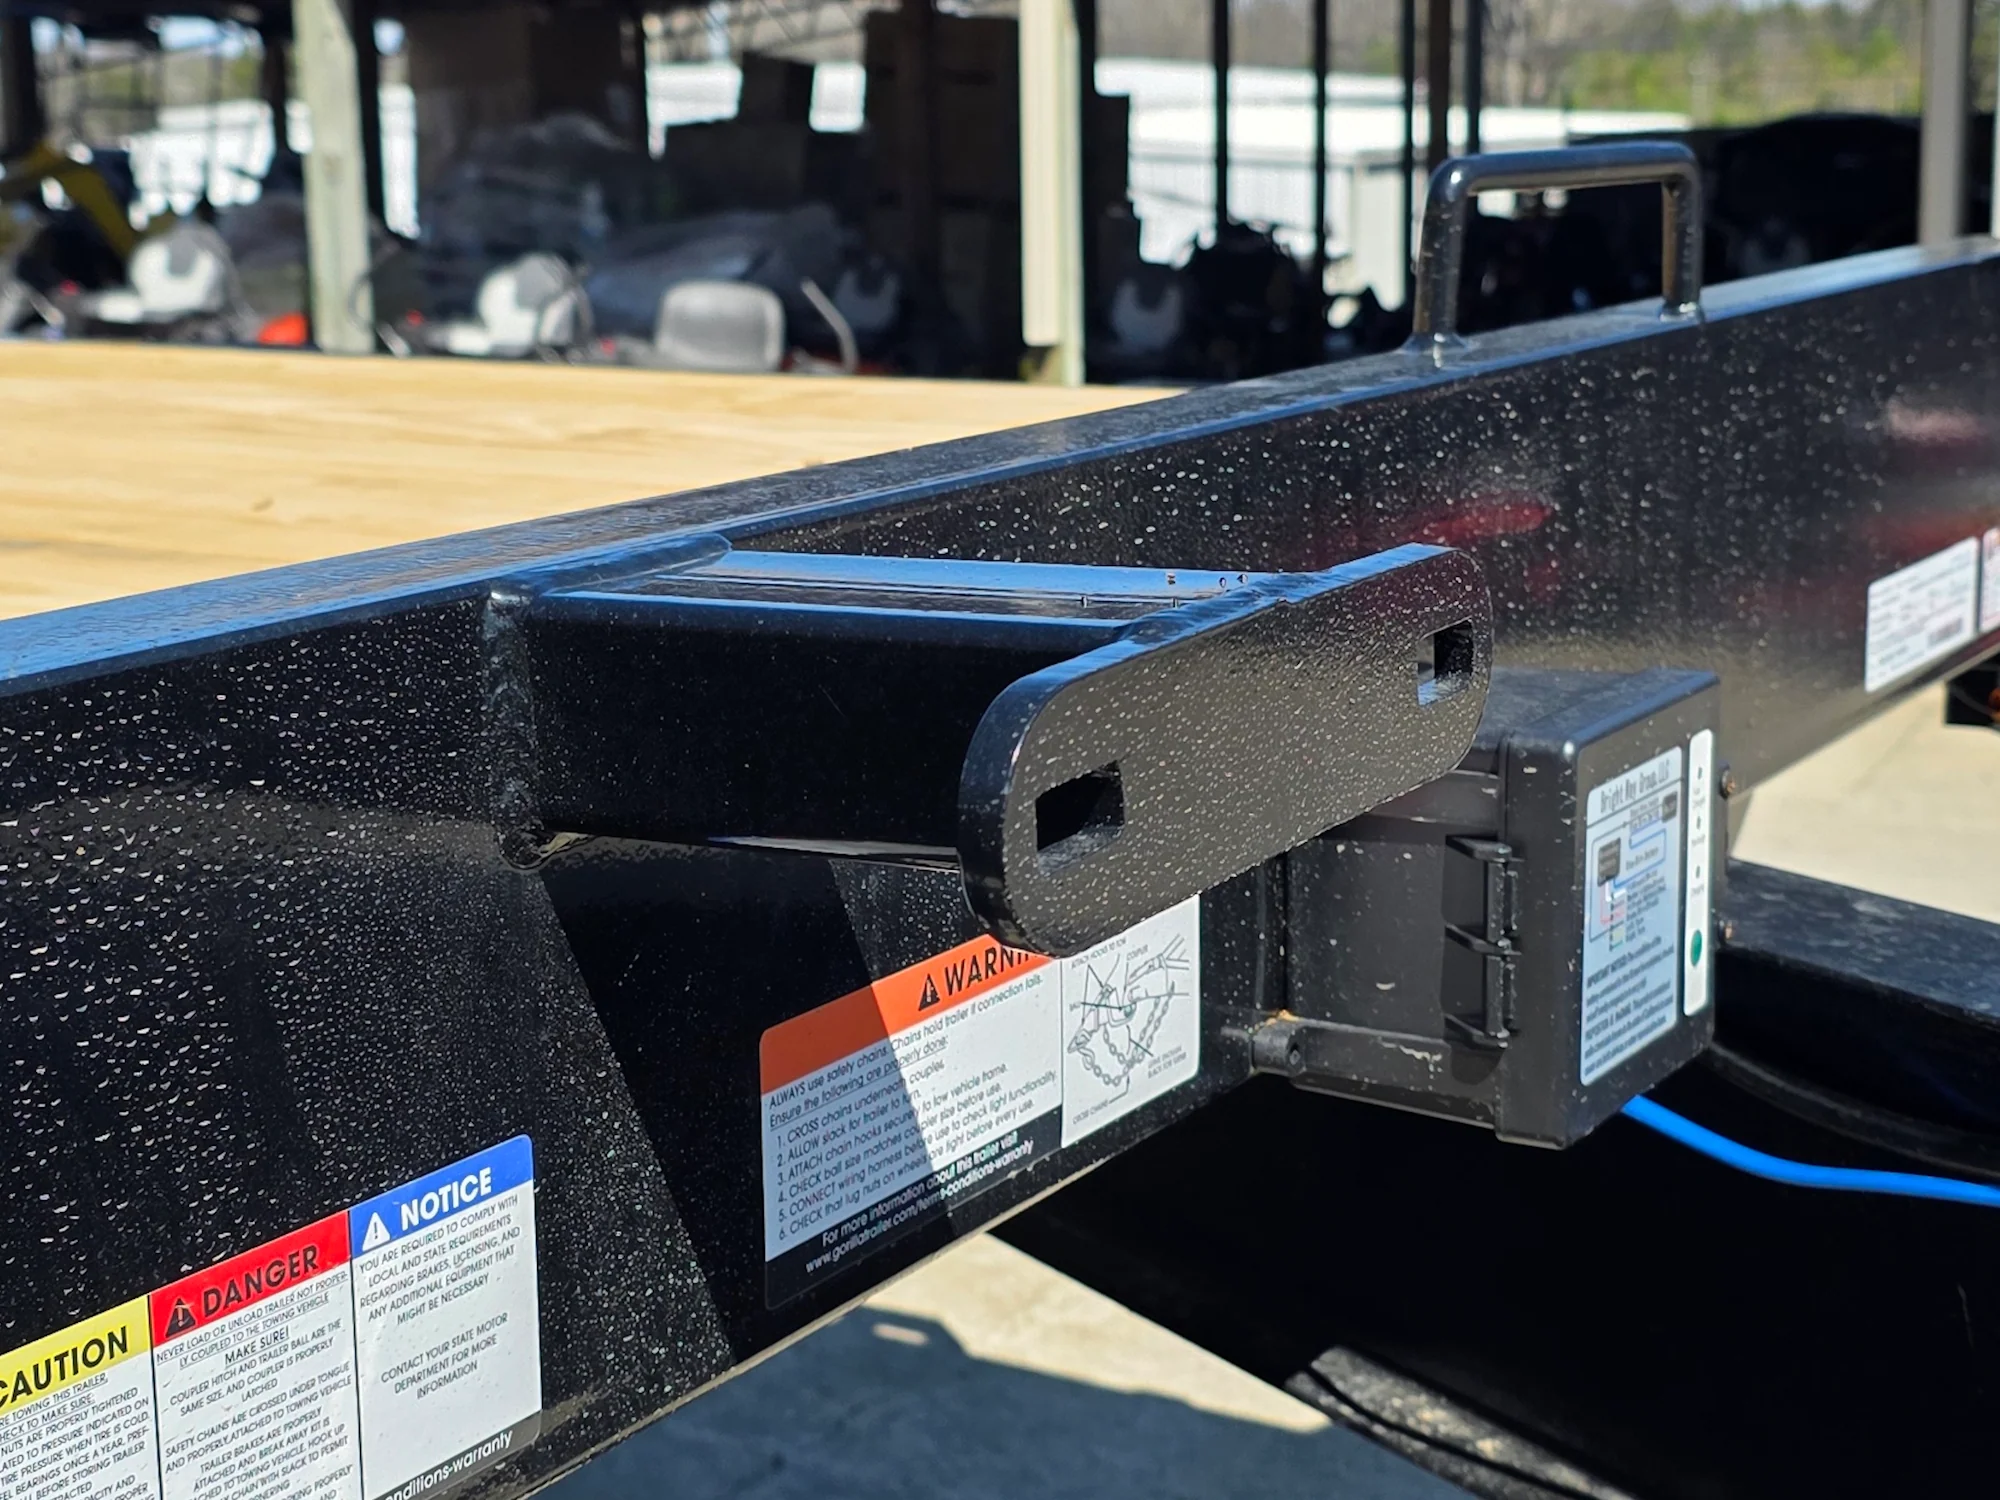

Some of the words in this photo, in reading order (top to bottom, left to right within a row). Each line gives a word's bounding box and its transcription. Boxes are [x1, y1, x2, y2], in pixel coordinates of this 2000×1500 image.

[945, 946, 1037, 996] WARN
[769, 1081, 805, 1109] ALWAYS
[807, 1076, 823, 1092] use
[826, 1058, 854, 1084] safety
[891, 1027, 921, 1053] Chains
[923, 1017, 942, 1038] hold
[977, 979, 1023, 1012] connection
[770, 1101, 801, 1128] Ensure
[804, 1092, 819, 1111] the
[821, 1072, 863, 1105] following
[866, 1066, 881, 1082] are
[884, 1046, 920, 1075] properly
[777, 1132, 785, 1148] 1.
[787, 1116, 818, 1143] CROSS
[821, 1100, 851, 1127] chains
[854, 1074, 905, 1111] underneath
[777, 1151, 785, 1168] 2.
[788, 1135, 819, 1162] ALLOW
[822, 1122, 845, 1145] slack
[848, 1115, 861, 1132] for
[863, 1101, 888, 1125] trailer
[890, 1095, 900, 1110] to
[777, 1170, 786, 1186] 3.
[788, 1152, 822, 1181] ATTACH
[825, 1137, 852, 1162] chain
[854, 1122, 881, 1147] hooks
[789, 1171, 821, 1198] CHECK
[824, 1160, 841, 1181] ball
[844, 1151, 860, 1170] size
[863, 1130, 901, 1161] matches
[400, 1166, 493, 1231] NOTICE
[789, 1181, 835, 1217] CONNECT
[837, 1166, 865, 1194] wiring
[867, 1147, 902, 1176] harness
[935, 1124, 949, 1141] use
[789, 1206, 822, 1235] CHECK
[825, 1195, 842, 1216] that
[862, 1178, 880, 1196] nuts
[883, 1171, 894, 1185] on
[822, 1225, 837, 1248] For
[841, 1211, 867, 1238] more
[870, 1179, 924, 1222] information
[926, 1162, 955, 1192] about
[956, 1153, 972, 1175] this
[973, 1139, 999, 1166] trailer
[359, 1256, 379, 1274] YOU
[381, 1247, 398, 1265] ARE
[400, 1227, 444, 1256] REQUIRED
[446, 1221, 458, 1236] TO
[460, 1204, 496, 1229] COMPLY
[498, 1193, 518, 1213] WITH
[359, 1274, 414, 1309] REGARDING
[501, 1225, 520, 1244] AND
[368, 1263, 399, 1287] LOCAL
[401, 1253, 421, 1272] AND
[423, 1241, 447, 1262] STATE
[448, 1213, 511, 1251] REQUIREMENTS
[203, 1245, 318, 1318] DANGER
[368, 1303, 387, 1322] ANY
[389, 1277, 443, 1312] ADDITIONAL
[445, 1254, 493, 1286] EQUIPMENT
[494, 1243, 514, 1263] THAT
[397, 1301, 426, 1325] MIGHT
[428, 1295, 439, 1311] BE
[441, 1272, 489, 1305] NECESSARY
[156, 1341, 184, 1364] NEVER
[186, 1329, 211, 1350] LOAD
[212, 1323, 226, 1338] OR
[228, 1306, 263, 1331] UNLOAD
[264, 1292, 295, 1314] TRAILER
[296, 1283, 314, 1300] NOT
[179, 1355, 188, 1368] LY
[190, 1336, 231, 1363] COUPLED
[232, 1330, 244, 1343] TO
[245, 1322, 260, 1337] THE
[261, 1306, 294, 1330] TOWING
[296, 1290, 329, 1314] VEHICLE
[224, 1340, 256, 1366] MAKE
[259, 1324, 289, 1349] SURE!
[380, 1353, 424, 1384] CONTACT
[425, 1340, 450, 1362] YOUR
[451, 1327, 474, 1349] STATE
[476, 1311, 507, 1336] MOTOR
[169, 1379, 209, 1407] COUPLER
[211, 1367, 236, 1387] HITCH
[238, 1357, 256, 1375] AND
[258, 1342, 289, 1365] TRAILER
[290, 1332, 309, 1350] BALL
[310, 1325, 325, 1341] ARE
[327, 1317, 341, 1333] THE
[180, 1397, 204, 1417] SAME
[225, 1377, 244, 1395] AND
[246, 1359, 284, 1385] COUPLER
[286, 1354, 293, 1366] IS
[295, 1335, 333, 1363] PROPERLY
[241, 1376, 278, 1403] LATCHED
[394, 1357, 449, 1394] DEPARTMENT
[451, 1346, 469, 1366] FOR
[471, 1332, 497, 1356] MORE
[416, 1358, 478, 1400] INFORMATION
[1, 1438, 23, 1457] NUTS
[25, 1429, 43, 1446] ARE
[45, 1408, 89, 1437] PROPERLY
[91, 1386, 138, 1416] TIGHTENED
[13, 1396, 50, 1422] TOWING
[52, 1387, 71, 1404] THIS
[26, 1415, 39, 1430] TO
[41, 1403, 68, 1424] MAKE
[26, 1446, 38, 1460] TO
[41, 1425, 83, 1454] PRESSURE
[85, 1403, 131, 1433] INDICATED
[134, 1395, 149, 1411] ON
[165, 1435, 194, 1458] SAFETY
[196, 1418, 229, 1443] CHAINS
[231, 1409, 248, 1426] ARE
[249, 1391, 287, 1418] CROSSED
[288, 1377, 316, 1399] UNDER
[317, 1361, 349, 1385] TONGUE
[165, 1455, 184, 1474] AND
[273, 1406, 284, 1420] TO
[286, 1390, 319, 1414] TOWING
[320, 1373, 352, 1398] VEHICLE
[307, 1427, 333, 1449] HOOK
[334, 1422, 345, 1436] UP
[15, 1465, 60, 1495] BEARINGS
[63, 1452, 90, 1473] ONCE
[92, 1447, 99, 1459] A
[20, 1449, 63, 1478] PRESSURE
[65, 1435, 92, 1457] WHEN
[94, 1428, 109, 1444] TIRE
[113, 1422, 121, 1434] IS
[71, 1456, 110, 1483] STORING
[112, 1440, 145, 1464] TRAILER
[193, 1462, 236, 1492] ATTACHED
[237, 1451, 256, 1470] AND
[258, 1437, 284, 1459] BREAK
[285, 1425, 308, 1446] AWAY
[200, 1450, 232, 1474] TRAILER
[283, 1405, 322, 1433] PROPERLY
[280, 1455, 306, 1477] SLACK
[307, 1449, 319, 1463] TO
[115, 1473, 135, 1491] AND
